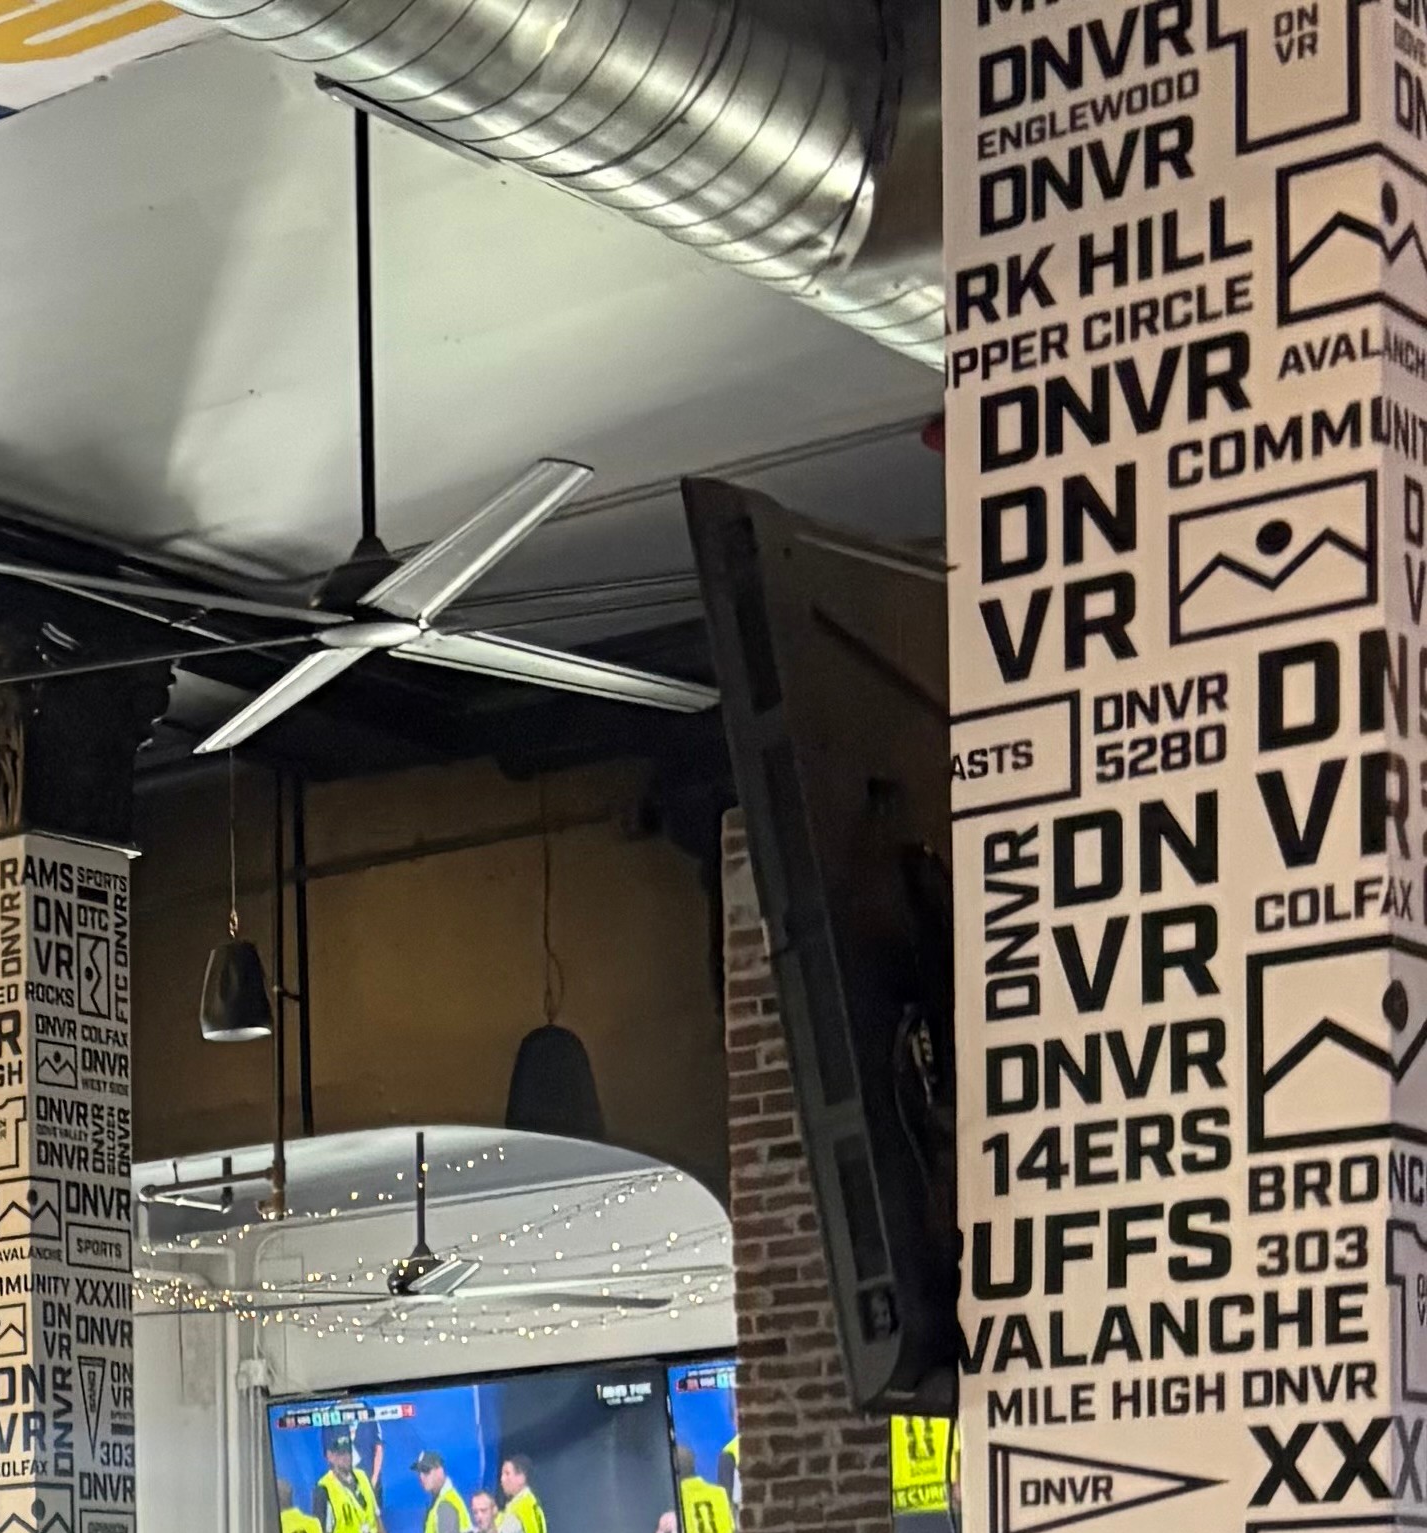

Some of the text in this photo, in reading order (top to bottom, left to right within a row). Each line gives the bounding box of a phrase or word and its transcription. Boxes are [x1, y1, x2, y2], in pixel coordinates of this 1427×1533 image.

[979, 0, 1195, 119] DNVR
[978, 68, 1199, 161] ENGLEWOOD
[979, 115, 1194, 237] DNVR
[1078, 196, 1253, 298] HILL
[1083, 272, 1253, 352] CIRCLE
[979, 331, 1252, 474] DNVR
[1094, 672, 1228, 735] DNVR
[1096, 724, 1227, 784] 5280
[0, 855, 74, 896] RAMS
[76, 865, 127, 892] SPORTS
[1256, 876, 1413, 933] COLFAX
[0, 891, 21, 979] DNVR
[985, 823, 1040, 1022] DNVR
[25, 981, 74, 1009] ROCKS
[35, 1014, 77, 1042] DNVR
[986, 1017, 1228, 1117] DNVR
[36, 1097, 88, 1129] DNVR
[37, 1141, 89, 1172] DNVR
[982, 1107, 1231, 1197] 14ERS
[1257, 1226, 1369, 1277] 303
[76, 1315, 133, 1348] DNVR
[54, 1365, 74, 1478] DNVR
[989, 1361, 1377, 1429] MILE HIGH DNVR
[79, 1472, 135, 1503] DNVR
[1020, 1475, 1113, 1506] DNVR
